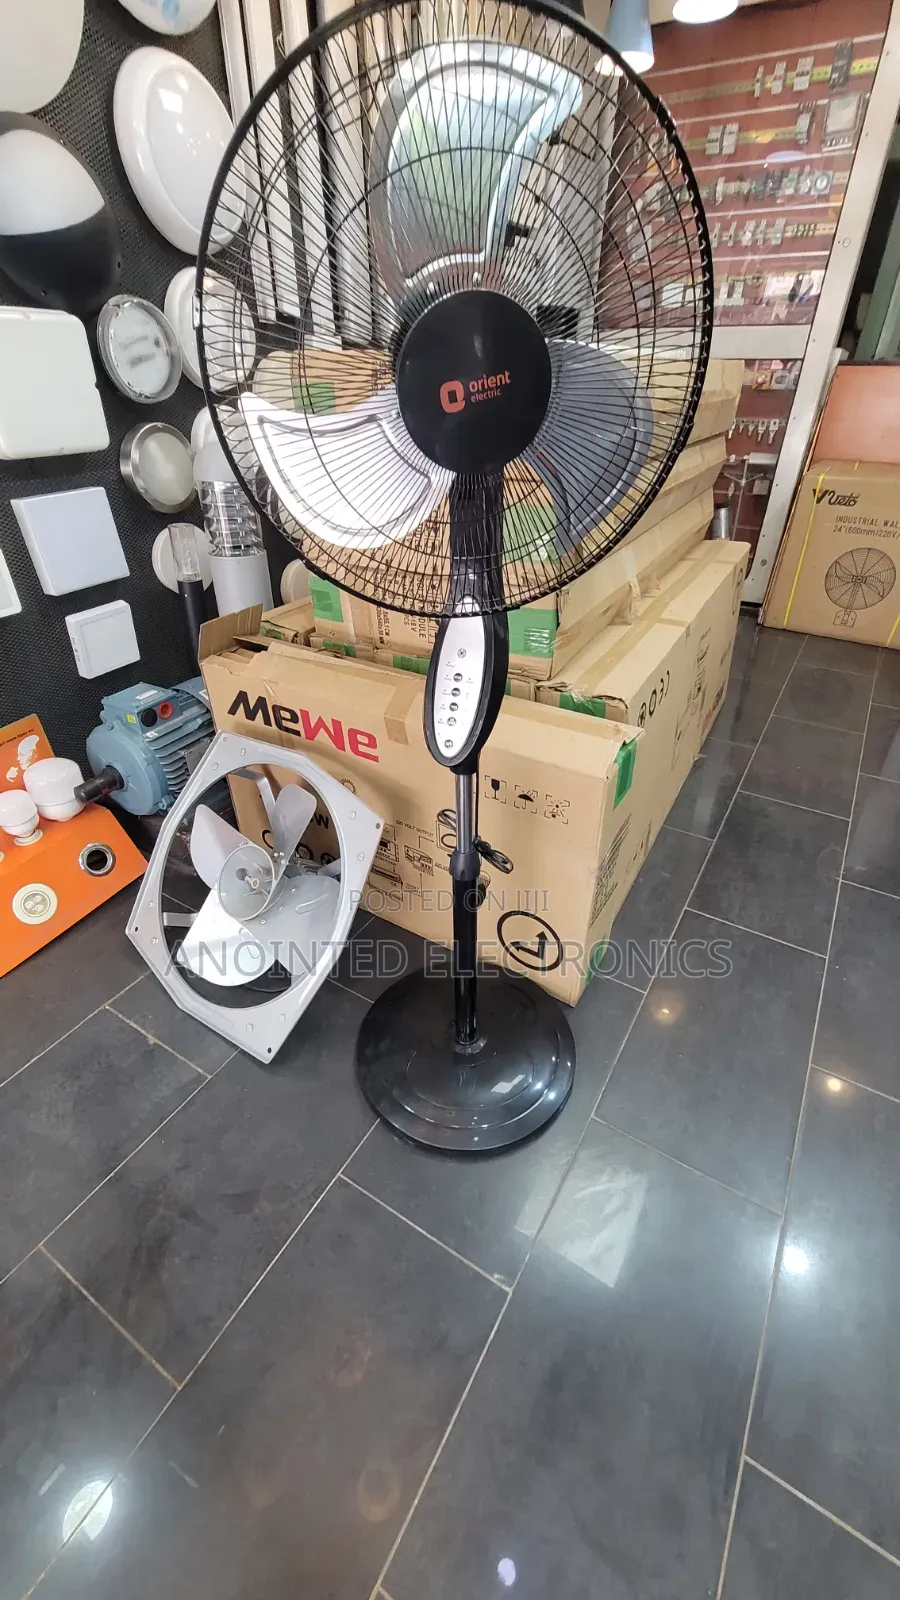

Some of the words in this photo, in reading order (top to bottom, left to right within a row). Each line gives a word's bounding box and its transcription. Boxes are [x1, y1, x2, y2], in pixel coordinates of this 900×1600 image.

[469, 370, 511, 393] orient
[470, 388, 502, 403] electric
[835, 514, 879, 527] INDUSTRIAL
[882, 519, 900, 529] WAL
